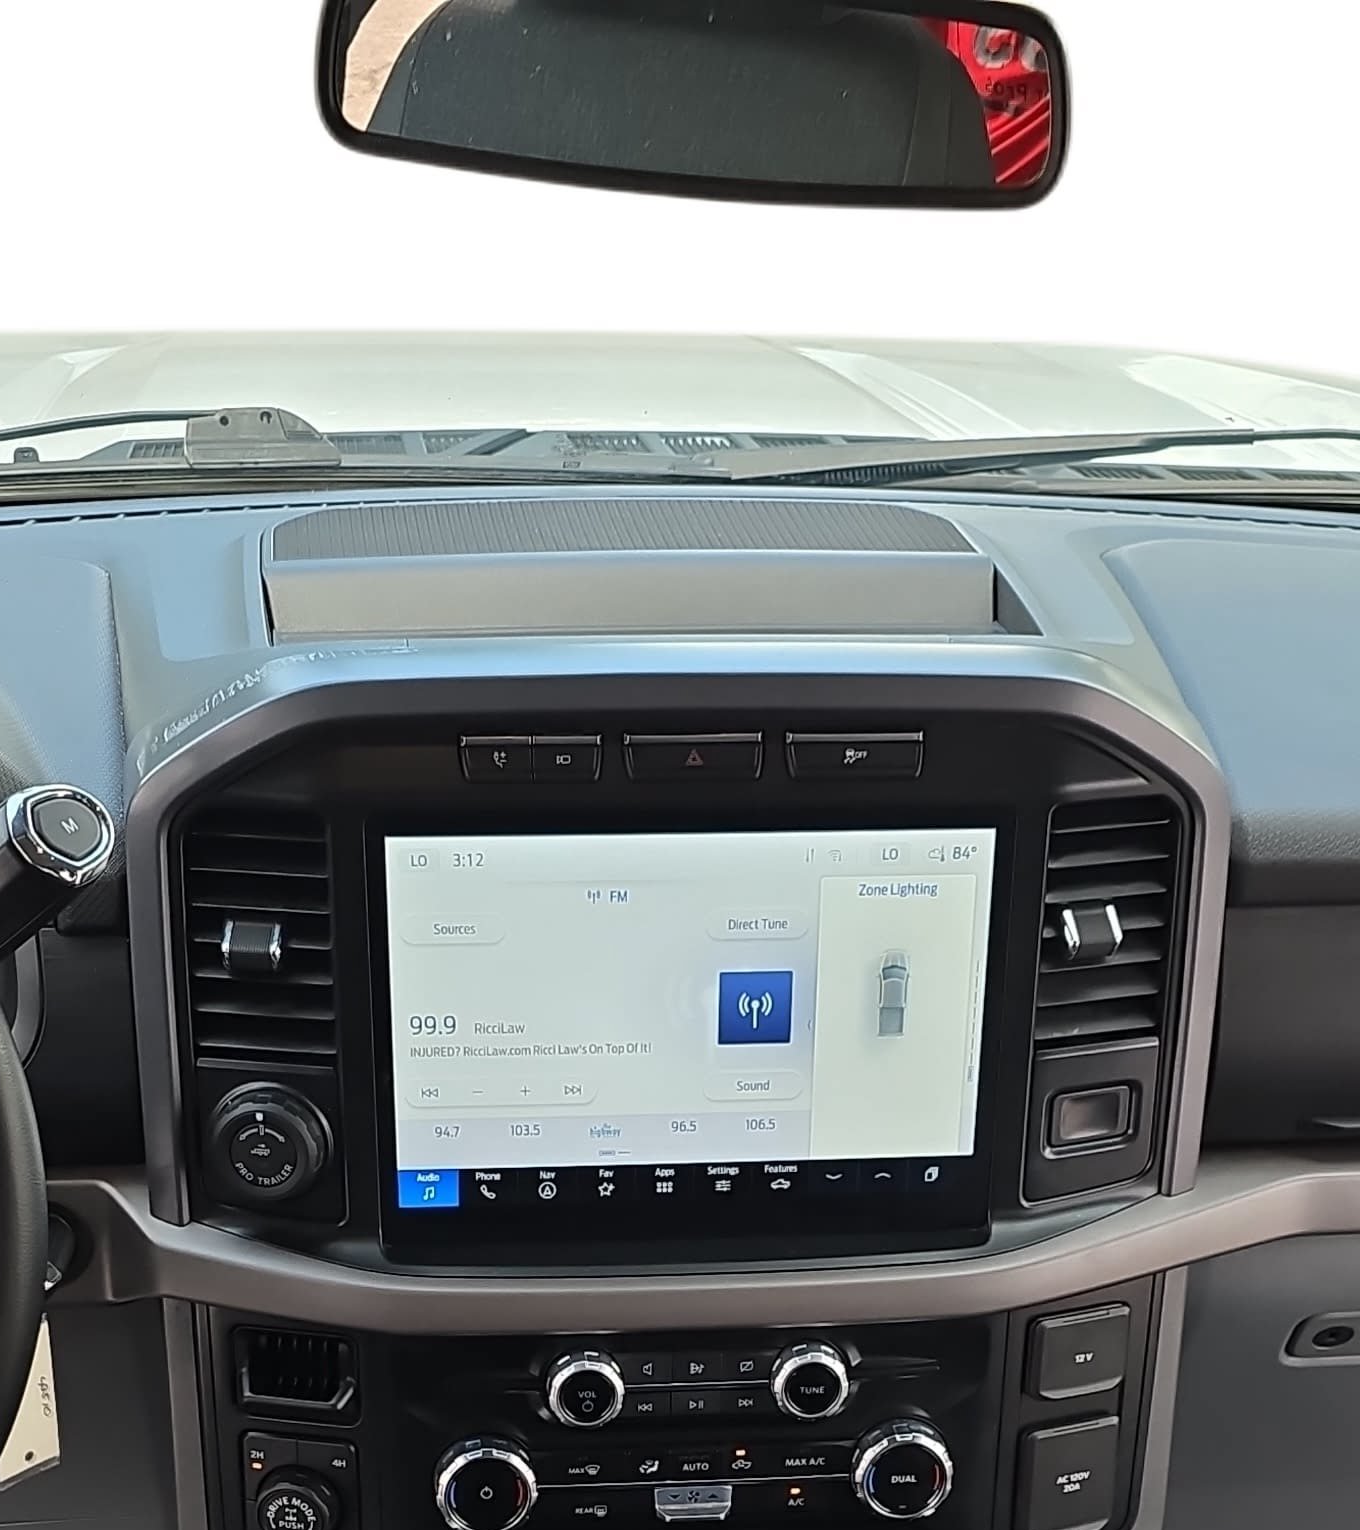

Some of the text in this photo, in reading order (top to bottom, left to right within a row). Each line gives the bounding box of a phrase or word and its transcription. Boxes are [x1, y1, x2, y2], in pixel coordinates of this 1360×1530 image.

[60, 817, 80, 836] M
[410, 852, 484, 868] LO 3:12
[882, 848, 899, 861] LO
[609, 890, 628, 903] FM
[859, 882, 938, 898] Zone Lighting
[433, 923, 476, 936] Sources
[728, 918, 788, 931] Direct Tune
[410, 1015, 526, 1036] 99.9 RicciLaw
[410, 1046, 461, 1058] INJURED?
[463, 1044, 531, 1057] RicciLaw.com
[533, 1044, 557, 1056] Ricci
[558, 1043, 588, 1055] Law's
[588, 1043, 603, 1054] On
[605, 1043, 625, 1056] Top
[626, 1042, 640, 1054] Of
[736, 1080, 770, 1092] Sound
[434, 1126, 460, 1138] 94.7
[510, 1124, 541, 1136] 103.5
[671, 1121, 697, 1132] 96.5
[745, 1119, 776, 1131] 106.5
[234, 1161, 294, 1186] PRO TRAILER
[416, 1165, 798, 1182] Audio Phone Nav Fav Apps Settings Features
[577, 1389, 597, 1399] VOL
[798, 1384, 825, 1395] TUNE
[249, 1450, 265, 1460] 2H
[331, 1459, 347, 1468] 4H
[682, 1462, 710, 1472] AUTO
[785, 1457, 826, 1468] MAX A/C
[568, 1466, 585, 1475] MAX
[890, 1473, 918, 1484] DUAL
[1056, 1470, 1091, 1485] AC 120V
[788, 1497, 805, 1507] A/C
[266, 1496, 317, 1522] DRIVE MODE
[575, 1506, 594, 1516] REAR
[279, 1520, 305, 1530] PUSH
